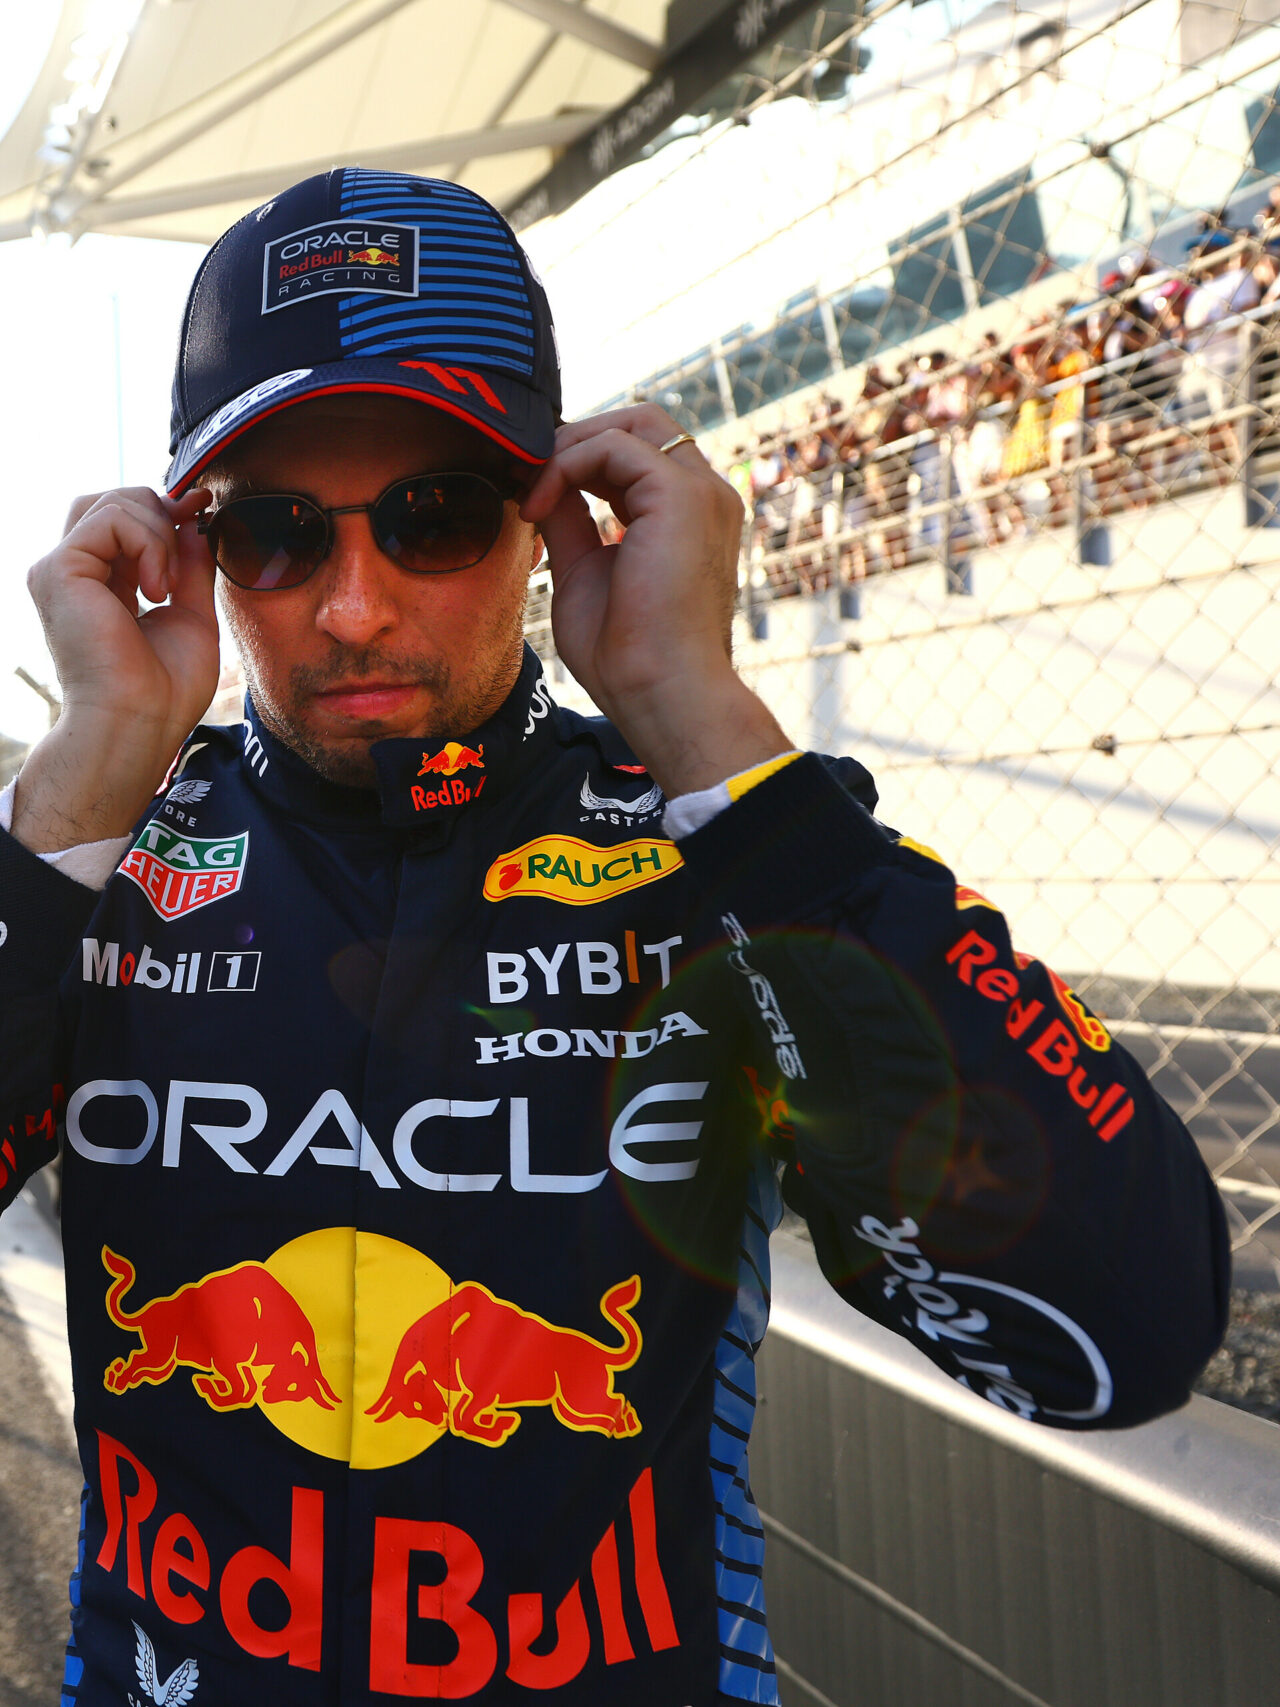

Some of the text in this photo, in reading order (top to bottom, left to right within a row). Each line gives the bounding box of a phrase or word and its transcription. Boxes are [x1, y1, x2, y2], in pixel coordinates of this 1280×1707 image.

[279, 250, 344, 280] Red Bull
[280, 231, 401, 260] ORACLE
[278, 271, 401, 297] RACING
[410, 779, 453, 812] Red
[579, 808, 663, 828] CASTOR
[145, 825, 238, 868] TAG
[527, 847, 663, 888] RAUCH
[125, 853, 235, 914] HEUER
[82, 938, 202, 994] Mobil
[486, 930, 683, 1005] BYBIT
[474, 1011, 709, 1065] HONDA
[944, 930, 1136, 1144] Red Bull
[65, 1079, 710, 1194] ORACLE
[94, 1428, 681, 1700] Red Bull
